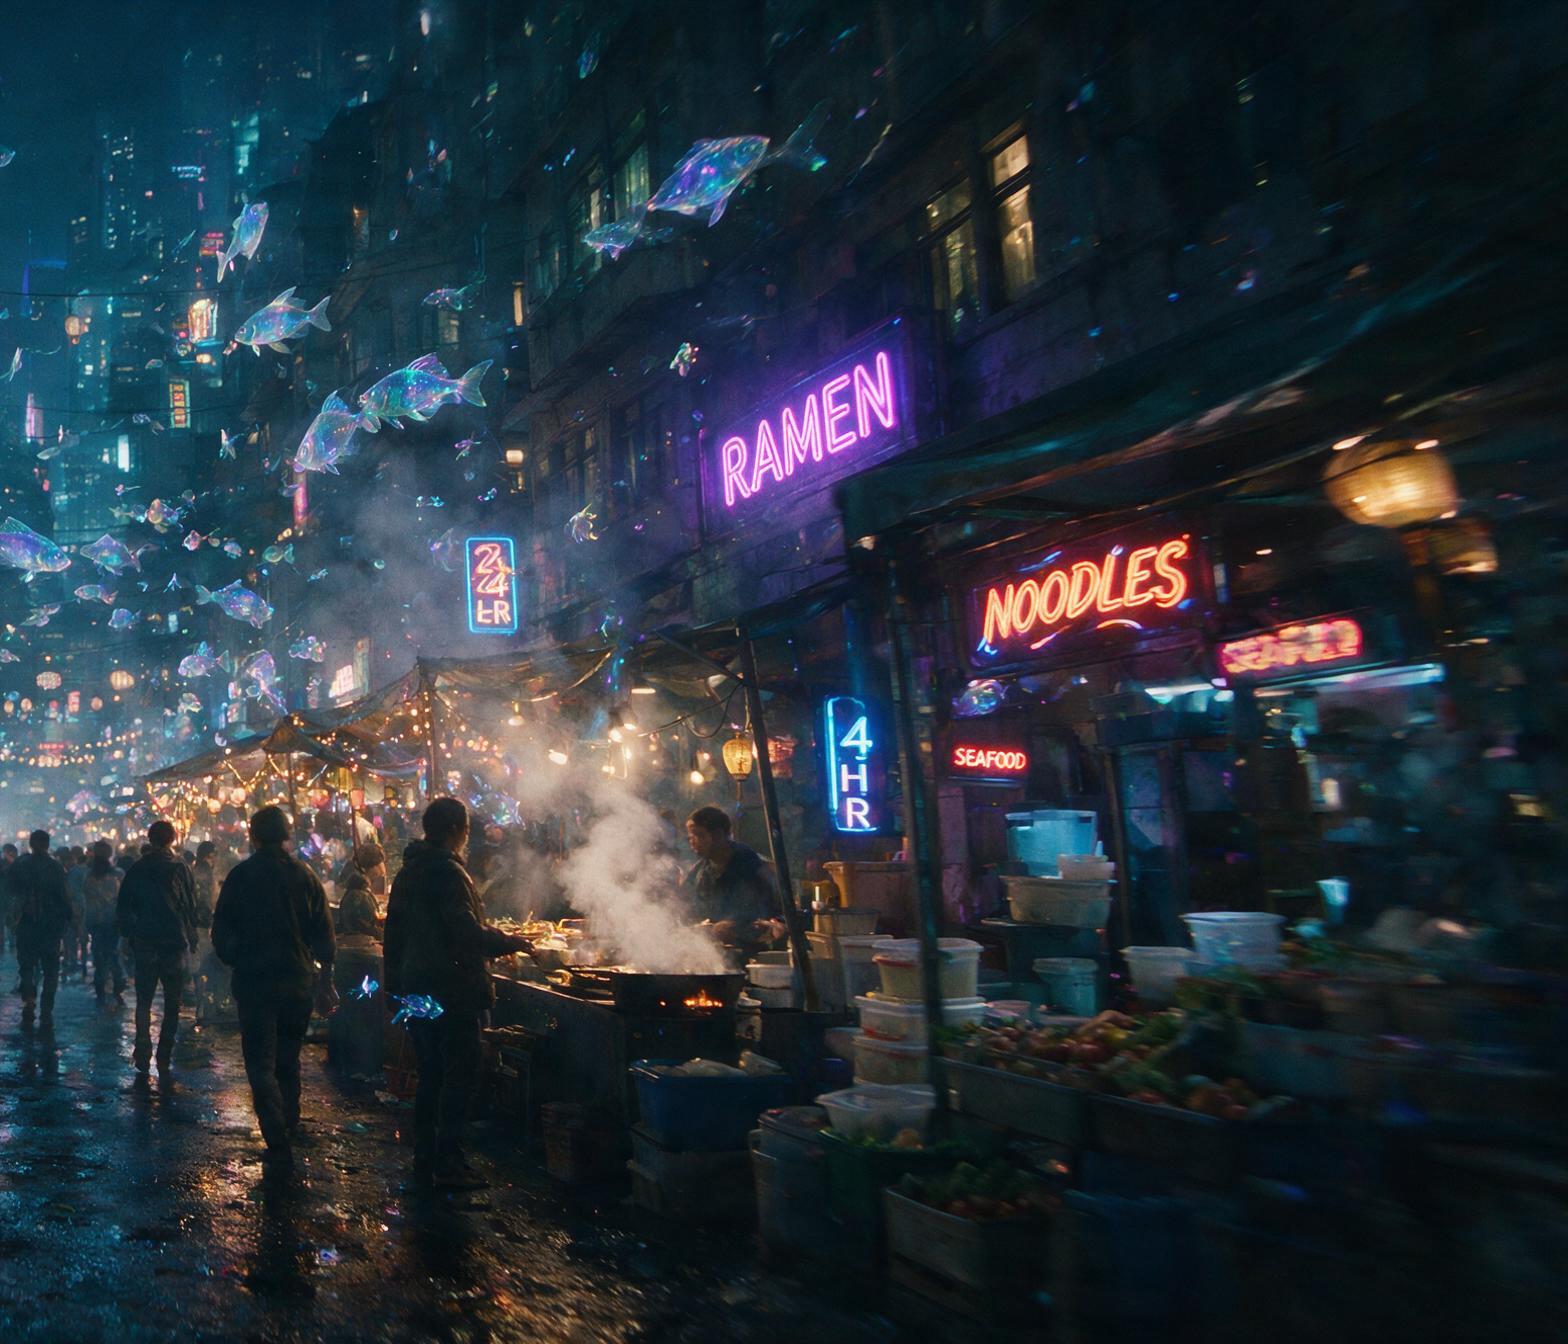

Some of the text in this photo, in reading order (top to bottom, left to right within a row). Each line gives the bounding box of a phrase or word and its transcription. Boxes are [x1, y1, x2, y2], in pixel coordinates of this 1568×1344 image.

[721, 351, 894, 507] RAMEN
[983, 540, 1188, 644] NOODLES
[953, 747, 1027, 770] SEAFOOD
